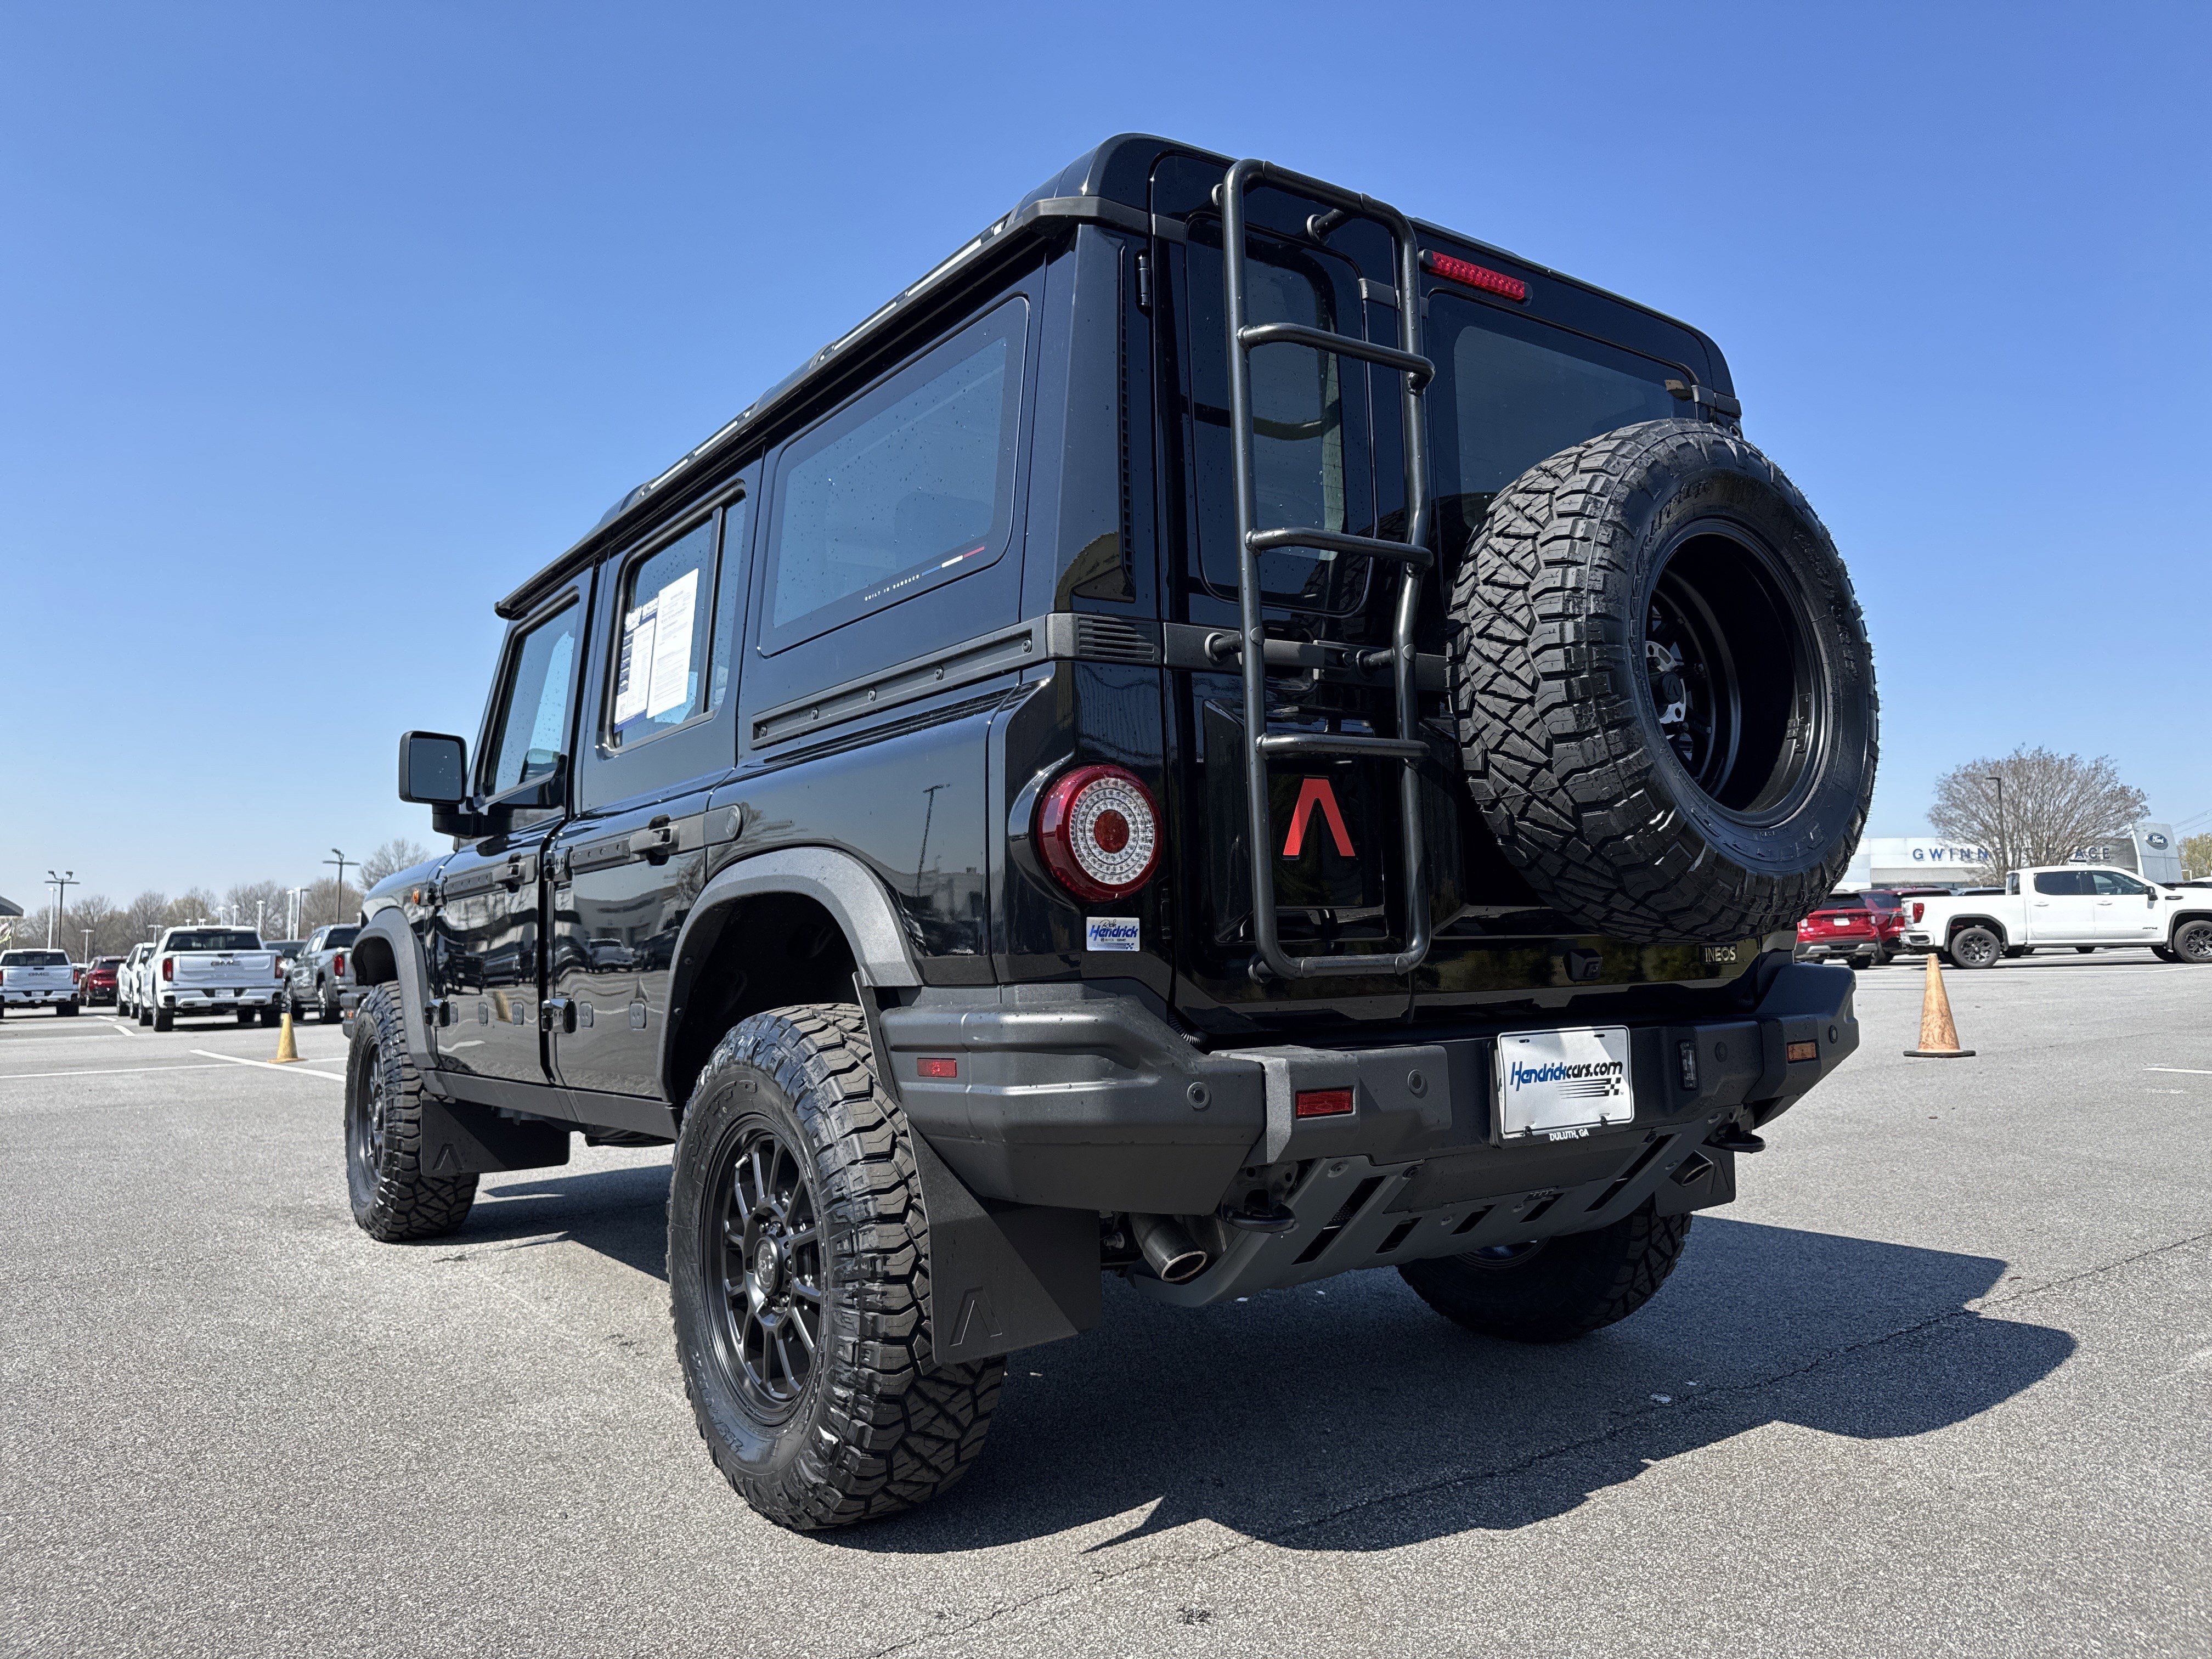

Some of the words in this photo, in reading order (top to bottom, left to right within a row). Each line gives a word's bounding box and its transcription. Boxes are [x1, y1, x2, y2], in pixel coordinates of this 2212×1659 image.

[1089, 925, 1138, 941] Hendrick
[1705, 946, 1736, 962] INEOS
[1510, 1061, 1623, 1092] Hendrickcars.com
[1549, 1130, 1579, 1142] DULUTH,
[1579, 1128, 1589, 1138] GA
